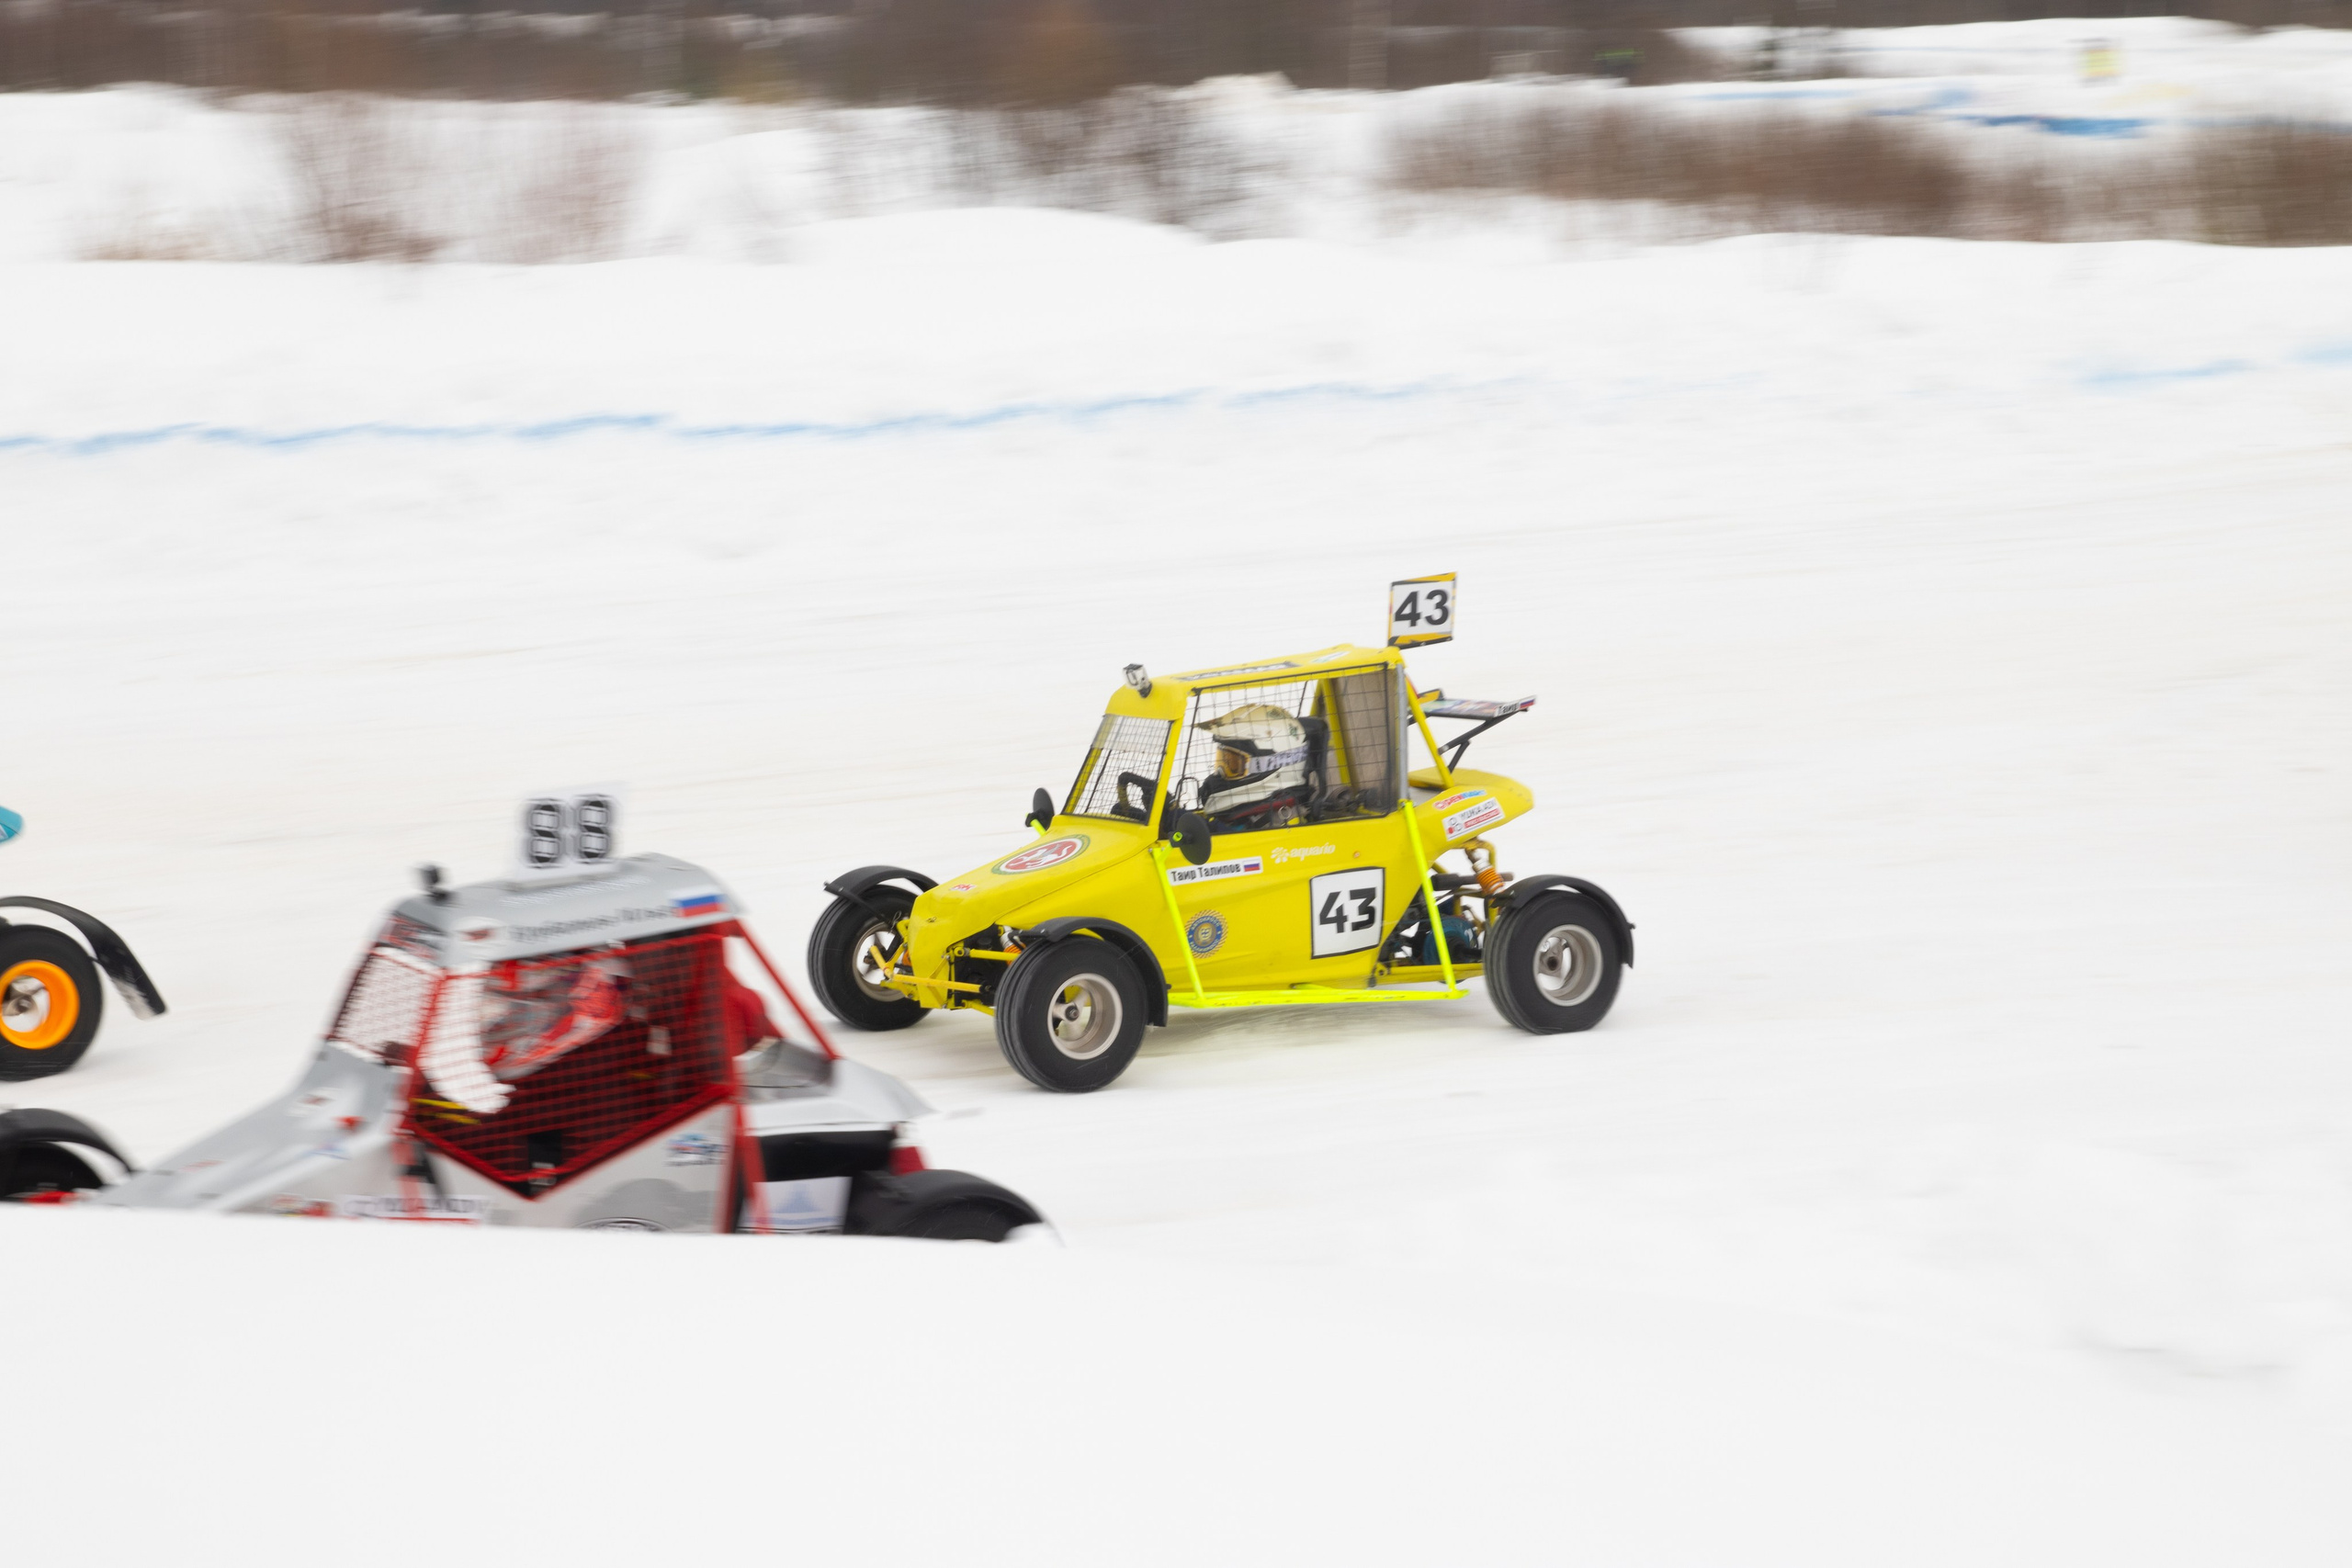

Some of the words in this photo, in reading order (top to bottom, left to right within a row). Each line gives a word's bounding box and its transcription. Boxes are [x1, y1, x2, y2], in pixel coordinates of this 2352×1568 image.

[1395, 589, 1449, 626] 43
[526, 797, 614, 868] 88
[1171, 870, 1197, 882] Таир
[1198, 863, 1241, 878] Талипов
[1319, 886, 1376, 934] 43
